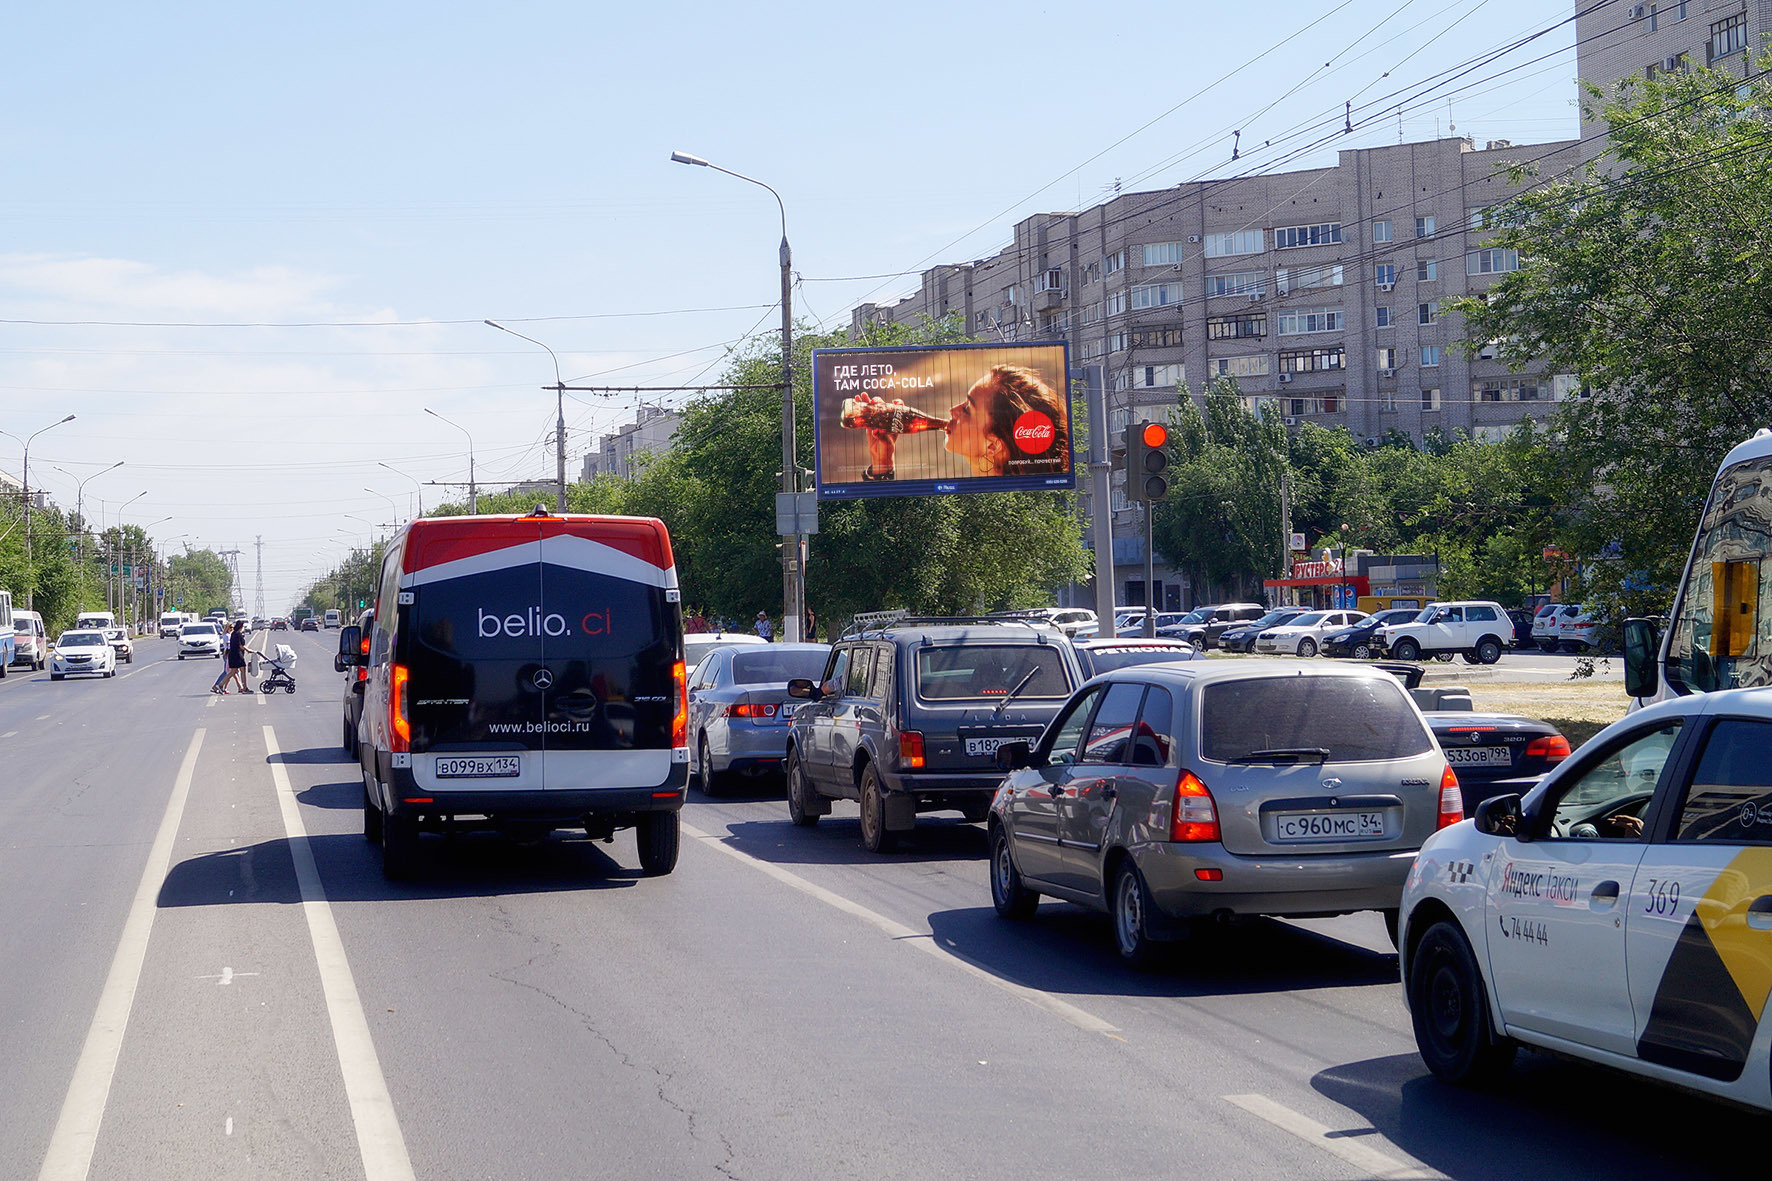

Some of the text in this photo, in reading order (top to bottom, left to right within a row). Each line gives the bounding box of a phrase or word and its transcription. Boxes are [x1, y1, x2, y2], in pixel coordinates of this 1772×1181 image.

[834, 364, 897, 378] ГДЕ ЛЕТО,
[834, 377, 934, 391] ТАМ COCA-COLA
[1015, 425, 1051, 440] Coca-Cola
[478, 606, 611, 638] belio. ci
[1093, 646, 1194, 656] PETRONAS
[489, 720, 590, 733] www.belioci.ru
[1444, 747, 1507, 762] 533ОВ 799
[496, 758, 516, 769] 134
[1361, 814, 1378, 828] 34
[1501, 862, 1579, 902] Яндекс Такси
[1645, 879, 1680, 916] 369
[1511, 917, 1548, 946] 74 44 44
